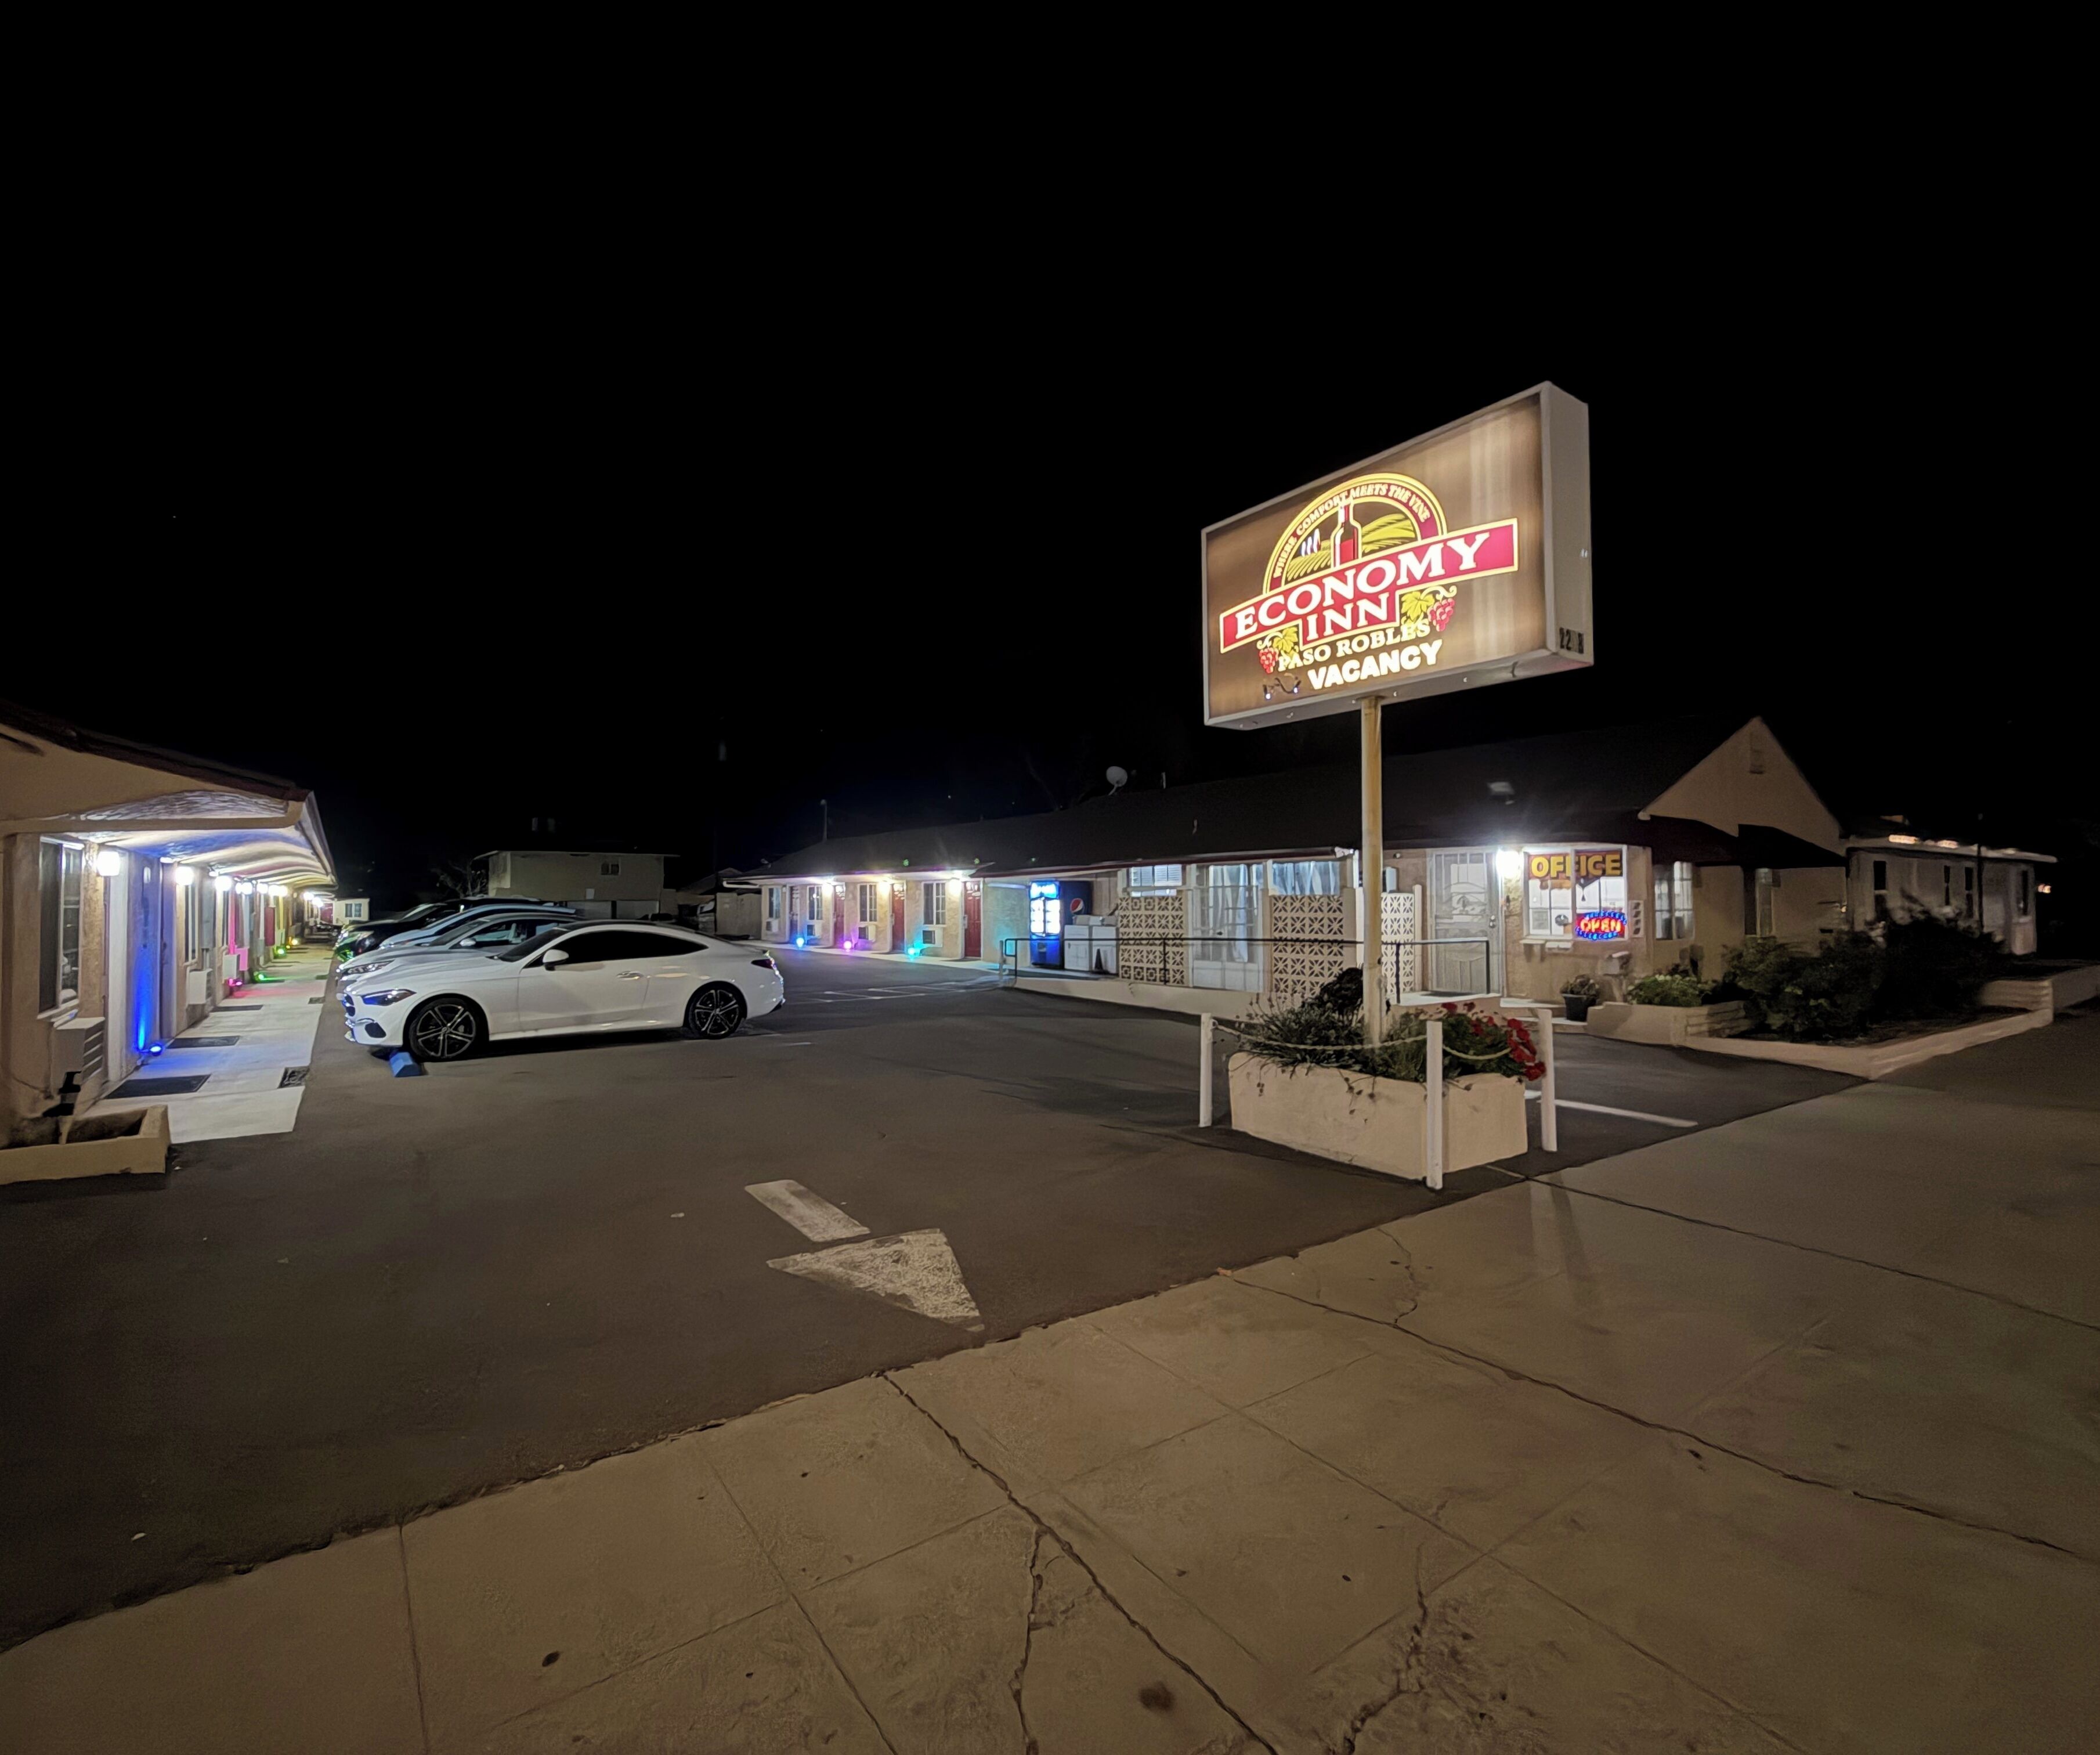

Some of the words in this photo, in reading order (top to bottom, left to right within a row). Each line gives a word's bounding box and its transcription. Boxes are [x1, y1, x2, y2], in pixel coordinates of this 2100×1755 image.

[1273, 535, 1297, 578] WHERE
[1296, 492, 1349, 536] COMFORT
[1350, 483, 1389, 500] MEETS
[1387, 485, 1412, 503] THE
[1408, 494, 1431, 523] VINE
[1235, 532, 1490, 640] ECONOMY
[1306, 592, 1390, 641] INN
[1277, 645, 1332, 672] PASO
[1336, 618, 1431, 658] ROBLES
[1307, 639, 1444, 691] VACANCY
[1531, 854, 1621, 878] OFFICE
[1580, 918, 1621, 933] OPEN
